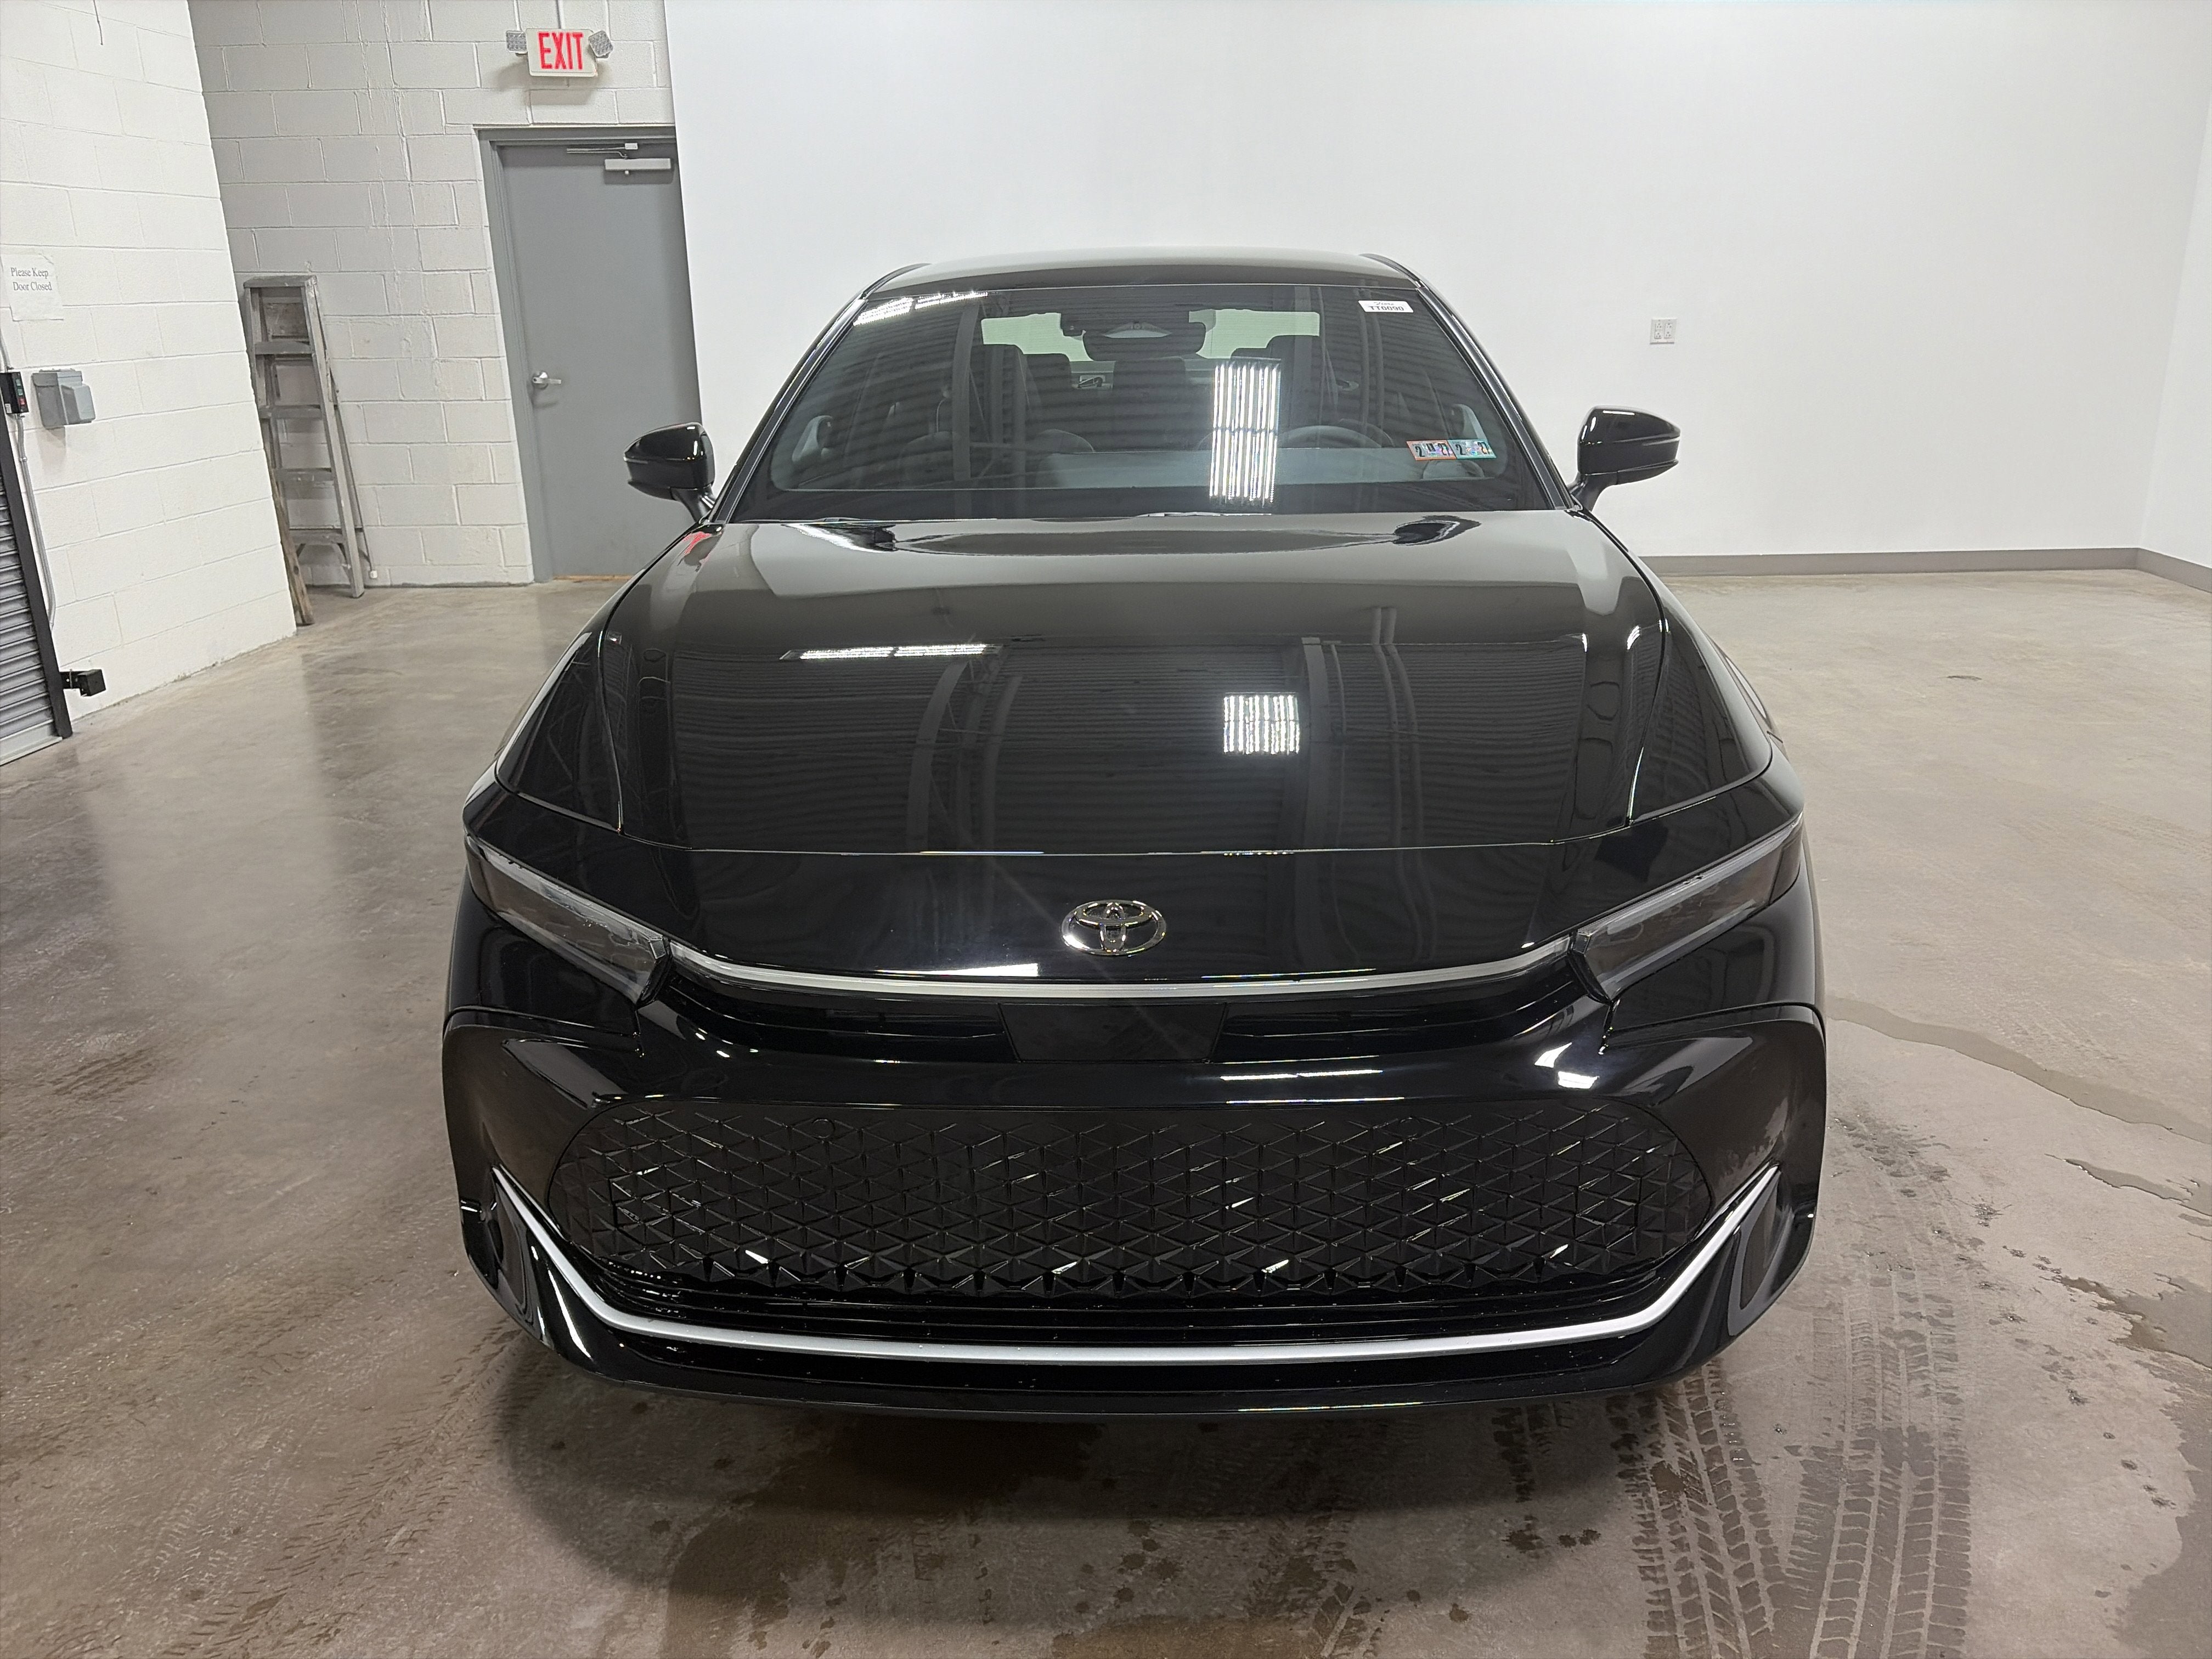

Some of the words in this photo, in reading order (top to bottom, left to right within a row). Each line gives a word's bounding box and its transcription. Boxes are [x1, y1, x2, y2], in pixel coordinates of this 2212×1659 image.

[538, 32, 583, 70] EXIT
[10, 267, 31, 276] Please
[32, 267, 48, 279] Keep
[13, 281, 29, 291] Door
[31, 281, 52, 291] Closed
